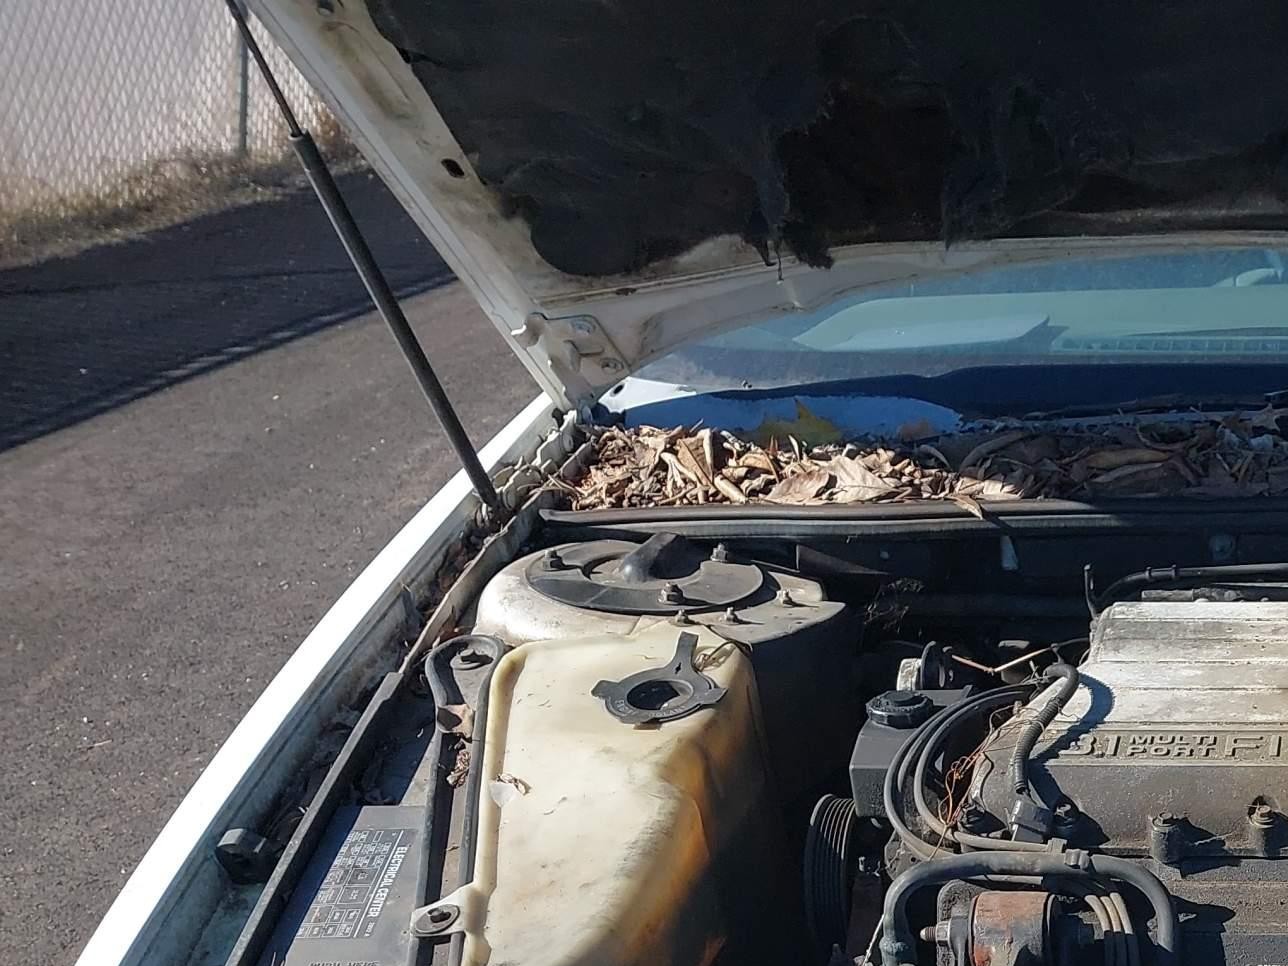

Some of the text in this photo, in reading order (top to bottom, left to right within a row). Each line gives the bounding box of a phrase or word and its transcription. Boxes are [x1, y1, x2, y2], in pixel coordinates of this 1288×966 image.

[1058, 733, 1282, 757] 3.1 MULTI PORT FI
[379, 846, 408, 888] ELECTRICAL
[367, 887, 389, 918] CENTER
